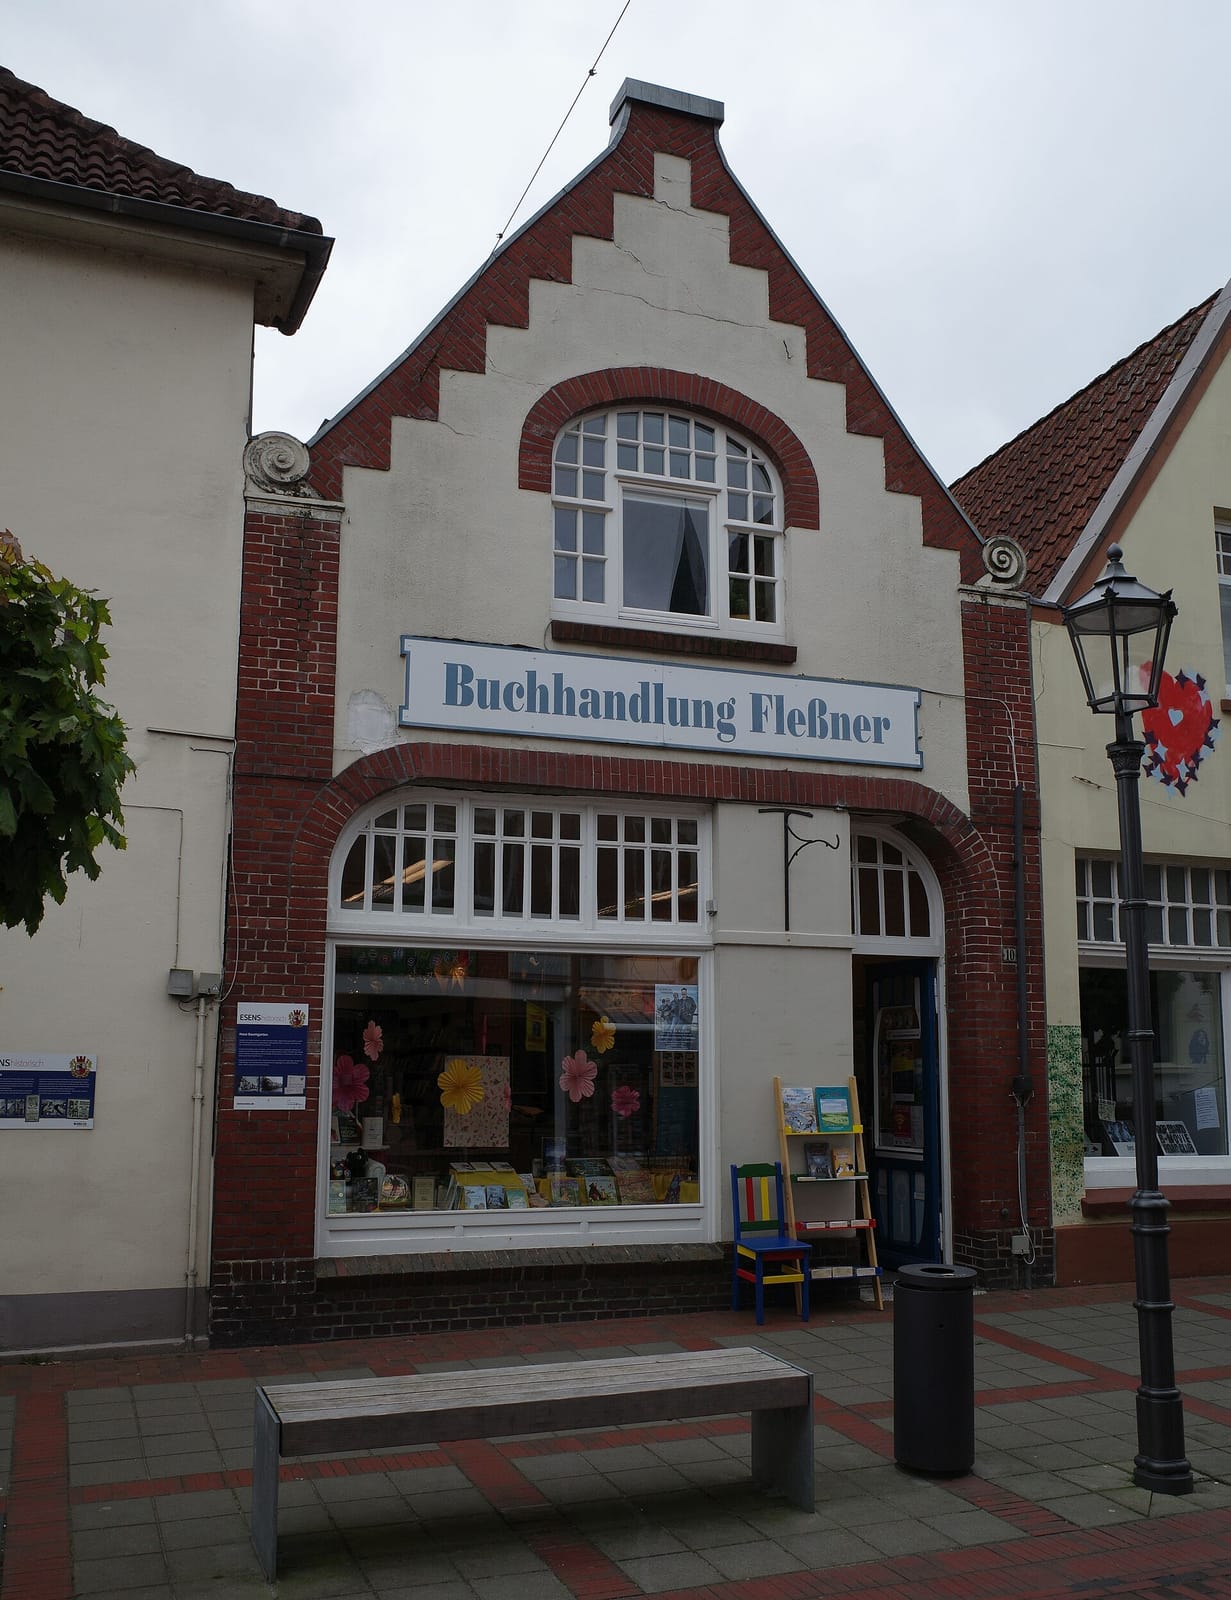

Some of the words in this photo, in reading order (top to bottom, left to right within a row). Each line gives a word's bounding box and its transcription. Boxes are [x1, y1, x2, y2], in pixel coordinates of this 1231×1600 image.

[443, 661, 736, 743] Buchhandlung
[749, 692, 892, 744] Fleßner
[1005, 948, 1015, 961] 10
[240, 1013, 262, 1022] ESENS
